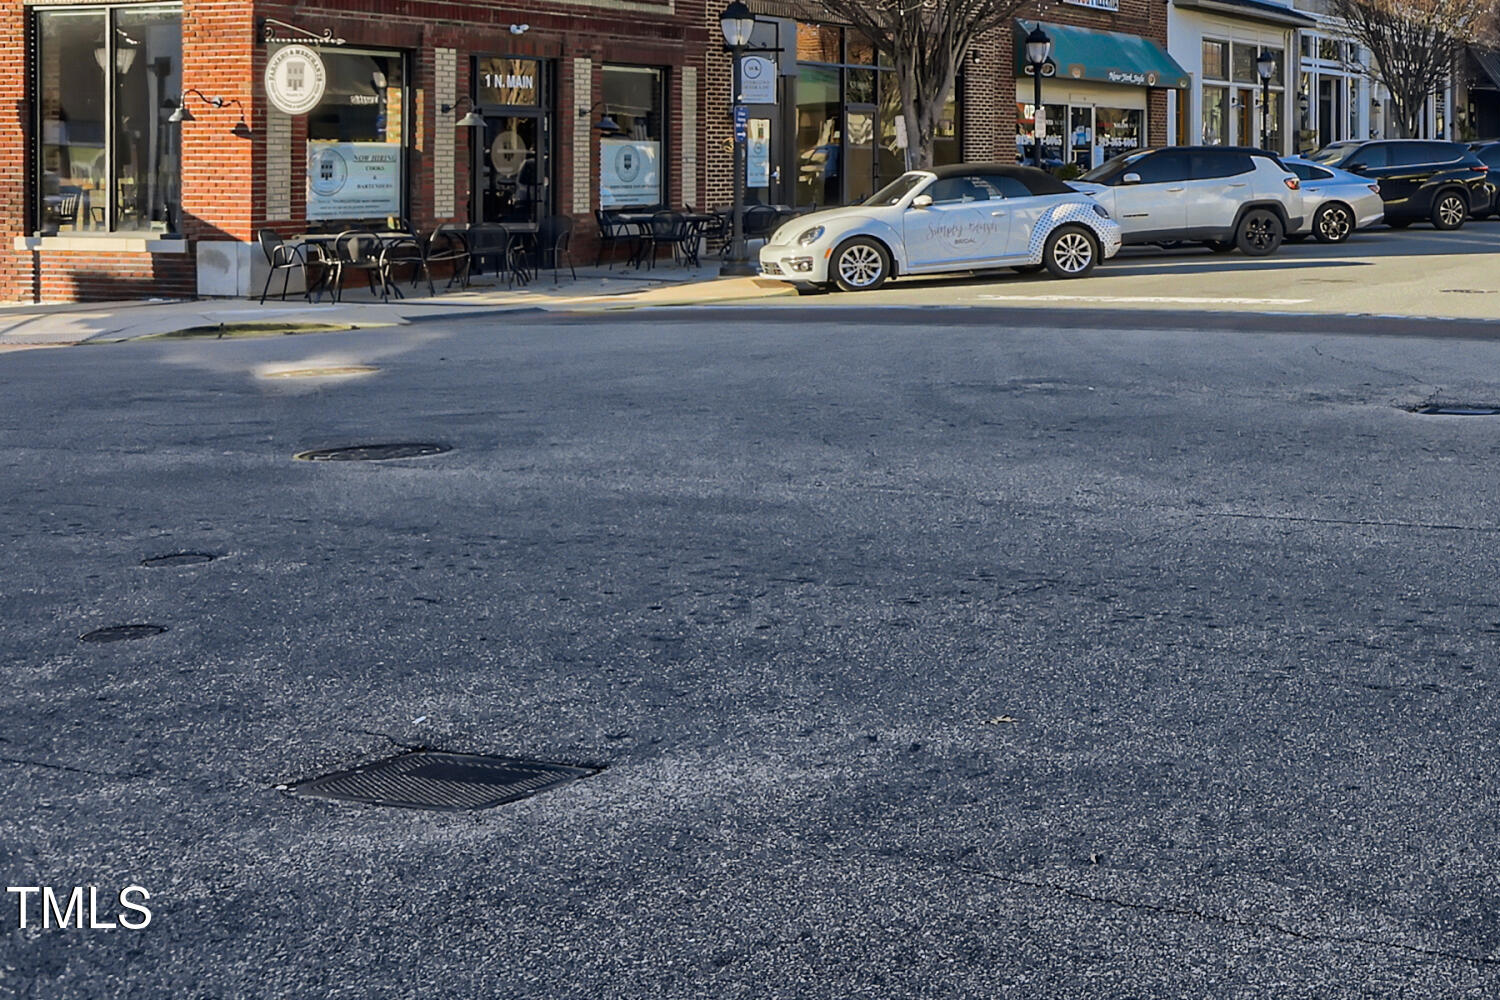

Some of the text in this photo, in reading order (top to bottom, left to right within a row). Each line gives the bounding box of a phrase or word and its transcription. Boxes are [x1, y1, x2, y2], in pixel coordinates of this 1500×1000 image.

[485, 74, 533, 89] 1 N. MAIN
